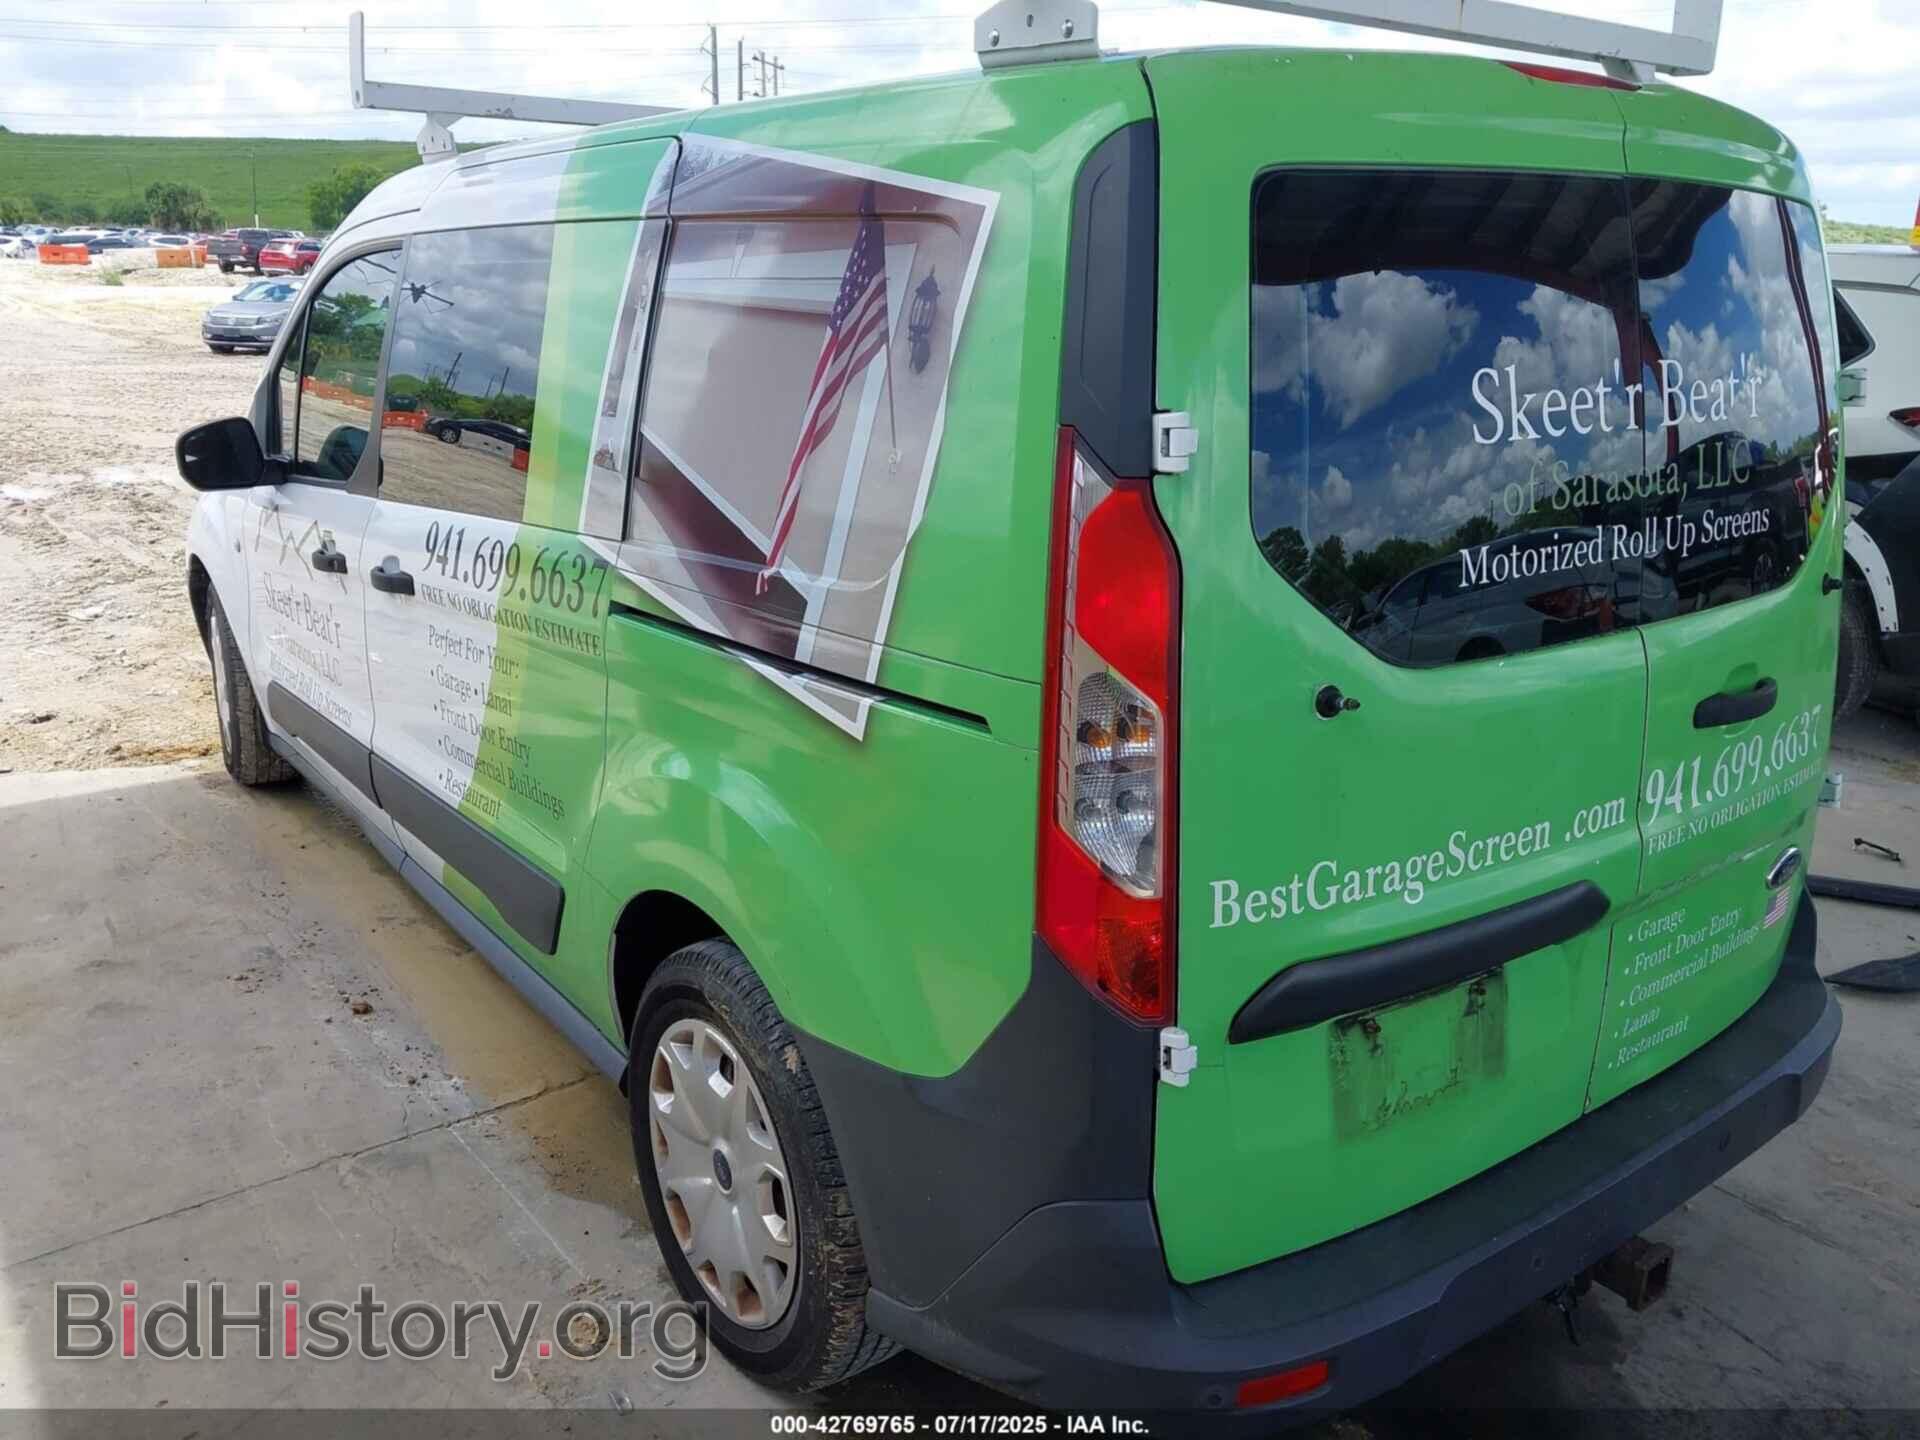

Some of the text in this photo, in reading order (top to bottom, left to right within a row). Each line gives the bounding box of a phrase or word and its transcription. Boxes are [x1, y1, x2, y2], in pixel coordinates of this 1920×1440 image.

[1471, 352, 1764, 446] Skeet'r Beat'r
[1503, 438, 1751, 517] of Sarasota, LLC
[422, 520, 610, 618] 941.699.6637
[1458, 506, 1770, 588] Motorized Roll Up Screens
[421, 584, 444, 606] FREE
[464, 596, 532, 632] OBLIGATION
[535, 617, 601, 656] ESTIMATE
[428, 624, 520, 678] Perfect For Your:
[436, 664, 513, 717] Garage Lanai
[440, 699, 531, 768] Front Door Entry
[1645, 704, 1822, 826] 941.699.6637
[443, 735, 565, 820] Commercial Buildings
[445, 768, 502, 820] Restaurant
[1648, 822, 1687, 856] FREE
[1688, 816, 1708, 840] NO
[1710, 783, 1782, 829] OBLIGATION
[1208, 796, 1626, 930] BestGarageScreen .com
[1633, 907, 1743, 976] Front Door Entry
[1638, 908, 1686, 942] Garage
[1629, 926, 1759, 1007] Commercial Buildings
[1616, 1016, 1689, 1068] Restaurant
